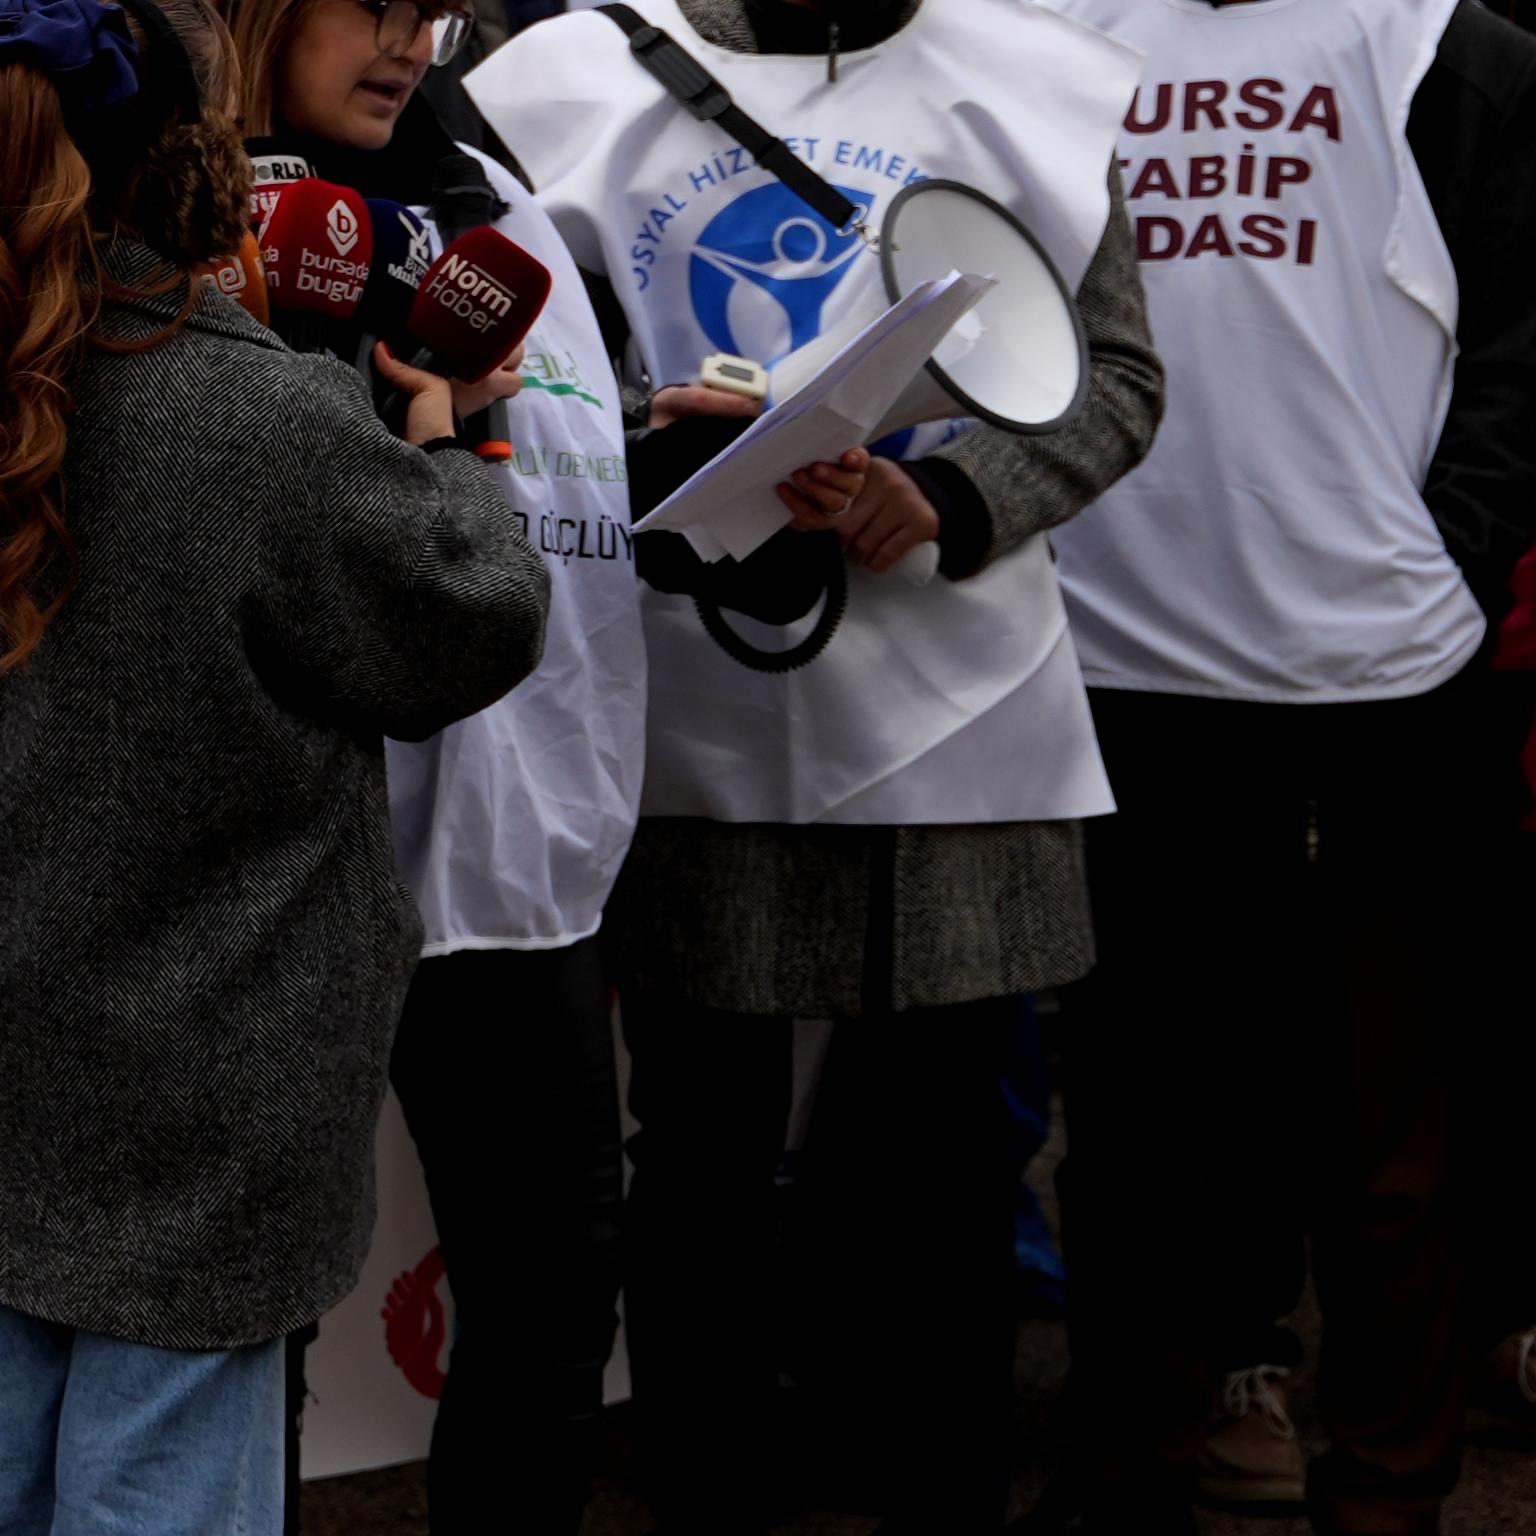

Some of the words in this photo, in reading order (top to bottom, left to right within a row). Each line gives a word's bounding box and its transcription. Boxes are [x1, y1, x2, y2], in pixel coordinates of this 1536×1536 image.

[1123, 77, 1342, 143] URSA
[834, 139, 929, 188] EMEK
[1119, 143, 1312, 201] ABİP
[1136, 214, 1317, 265] DASI
[297, 269, 364, 303] bugün
[425, 275, 498, 333] Haber
[439, 254, 513, 317] Norm
